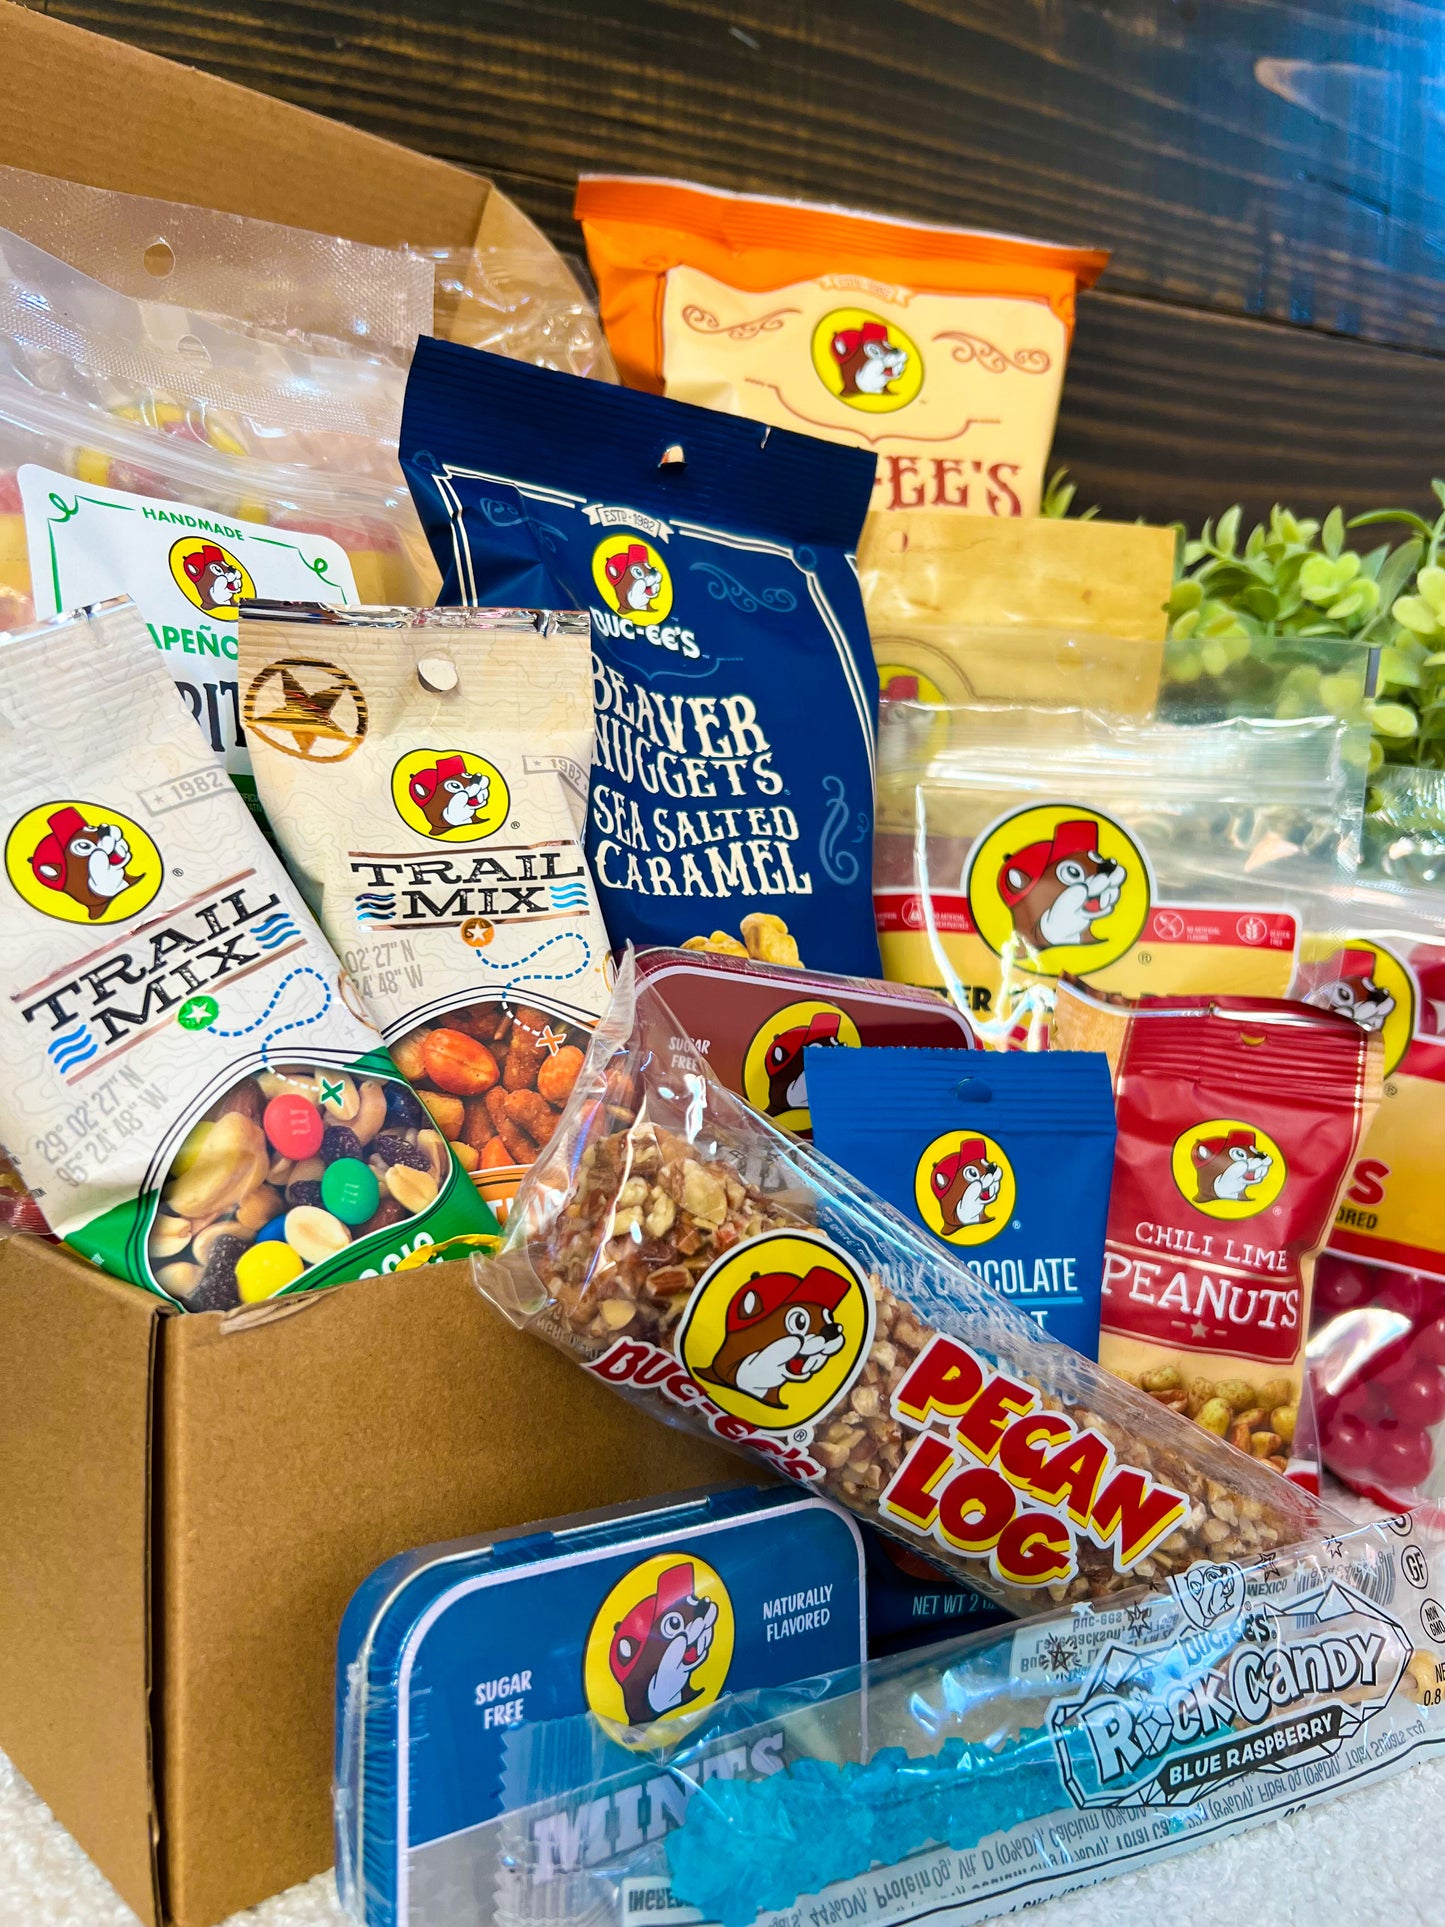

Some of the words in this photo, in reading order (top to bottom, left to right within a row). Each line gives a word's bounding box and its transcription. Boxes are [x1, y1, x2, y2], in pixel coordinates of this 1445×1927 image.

[142, 507, 244, 541] HANDMADE
[633, 513, 655, 533] 1982
[591, 654, 771, 759] BEAVER
[550, 759, 582, 788] 1982
[591, 714, 784, 799] NUGGETS
[171, 771, 225, 802] 1982
[594, 784, 652, 852] SEA
[655, 806, 800, 853] SALTED
[351, 852, 585, 887] TRAIL
[596, 839, 813, 898] CARAMEL
[402, 887, 550, 919] MIX
[21, 888, 281, 1032] TRAIL
[400, 938, 415, 963] N
[90, 933, 261, 1047] MIX
[403, 964, 424, 989] W
[669, 1036, 711, 1055] SUGAR
[671, 1054, 698, 1072] FREE
[1135, 1221, 1214, 1257] CHILI
[1224, 1239, 1288, 1272] LIME
[934, 1257, 1078, 1298] COCOLATE
[1101, 1251, 1299, 1330] PEANUTS
[896, 1337, 1186, 1567] PECAN
[885, 1434, 1072, 1585] LOG
[1405, 1551, 1426, 1582] GF
[762, 1583, 833, 1620] NATURALLY
[912, 1595, 940, 1616] NET
[943, 1593, 966, 1615] WT
[968, 1593, 979, 1612] 2
[1424, 1605, 1440, 1622] NON
[765, 1607, 831, 1643] FLAVORED
[1429, 1619, 1445, 1638] GMO
[475, 1669, 533, 1707] SUGAR
[1423, 1688, 1441, 1706] 0.8
[483, 1698, 524, 1730] FREE
[1168, 1756, 1223, 1786] BLUE
[1226, 1712, 1334, 1770] RASPBERRY
[532, 1732, 787, 1886] MINTS
